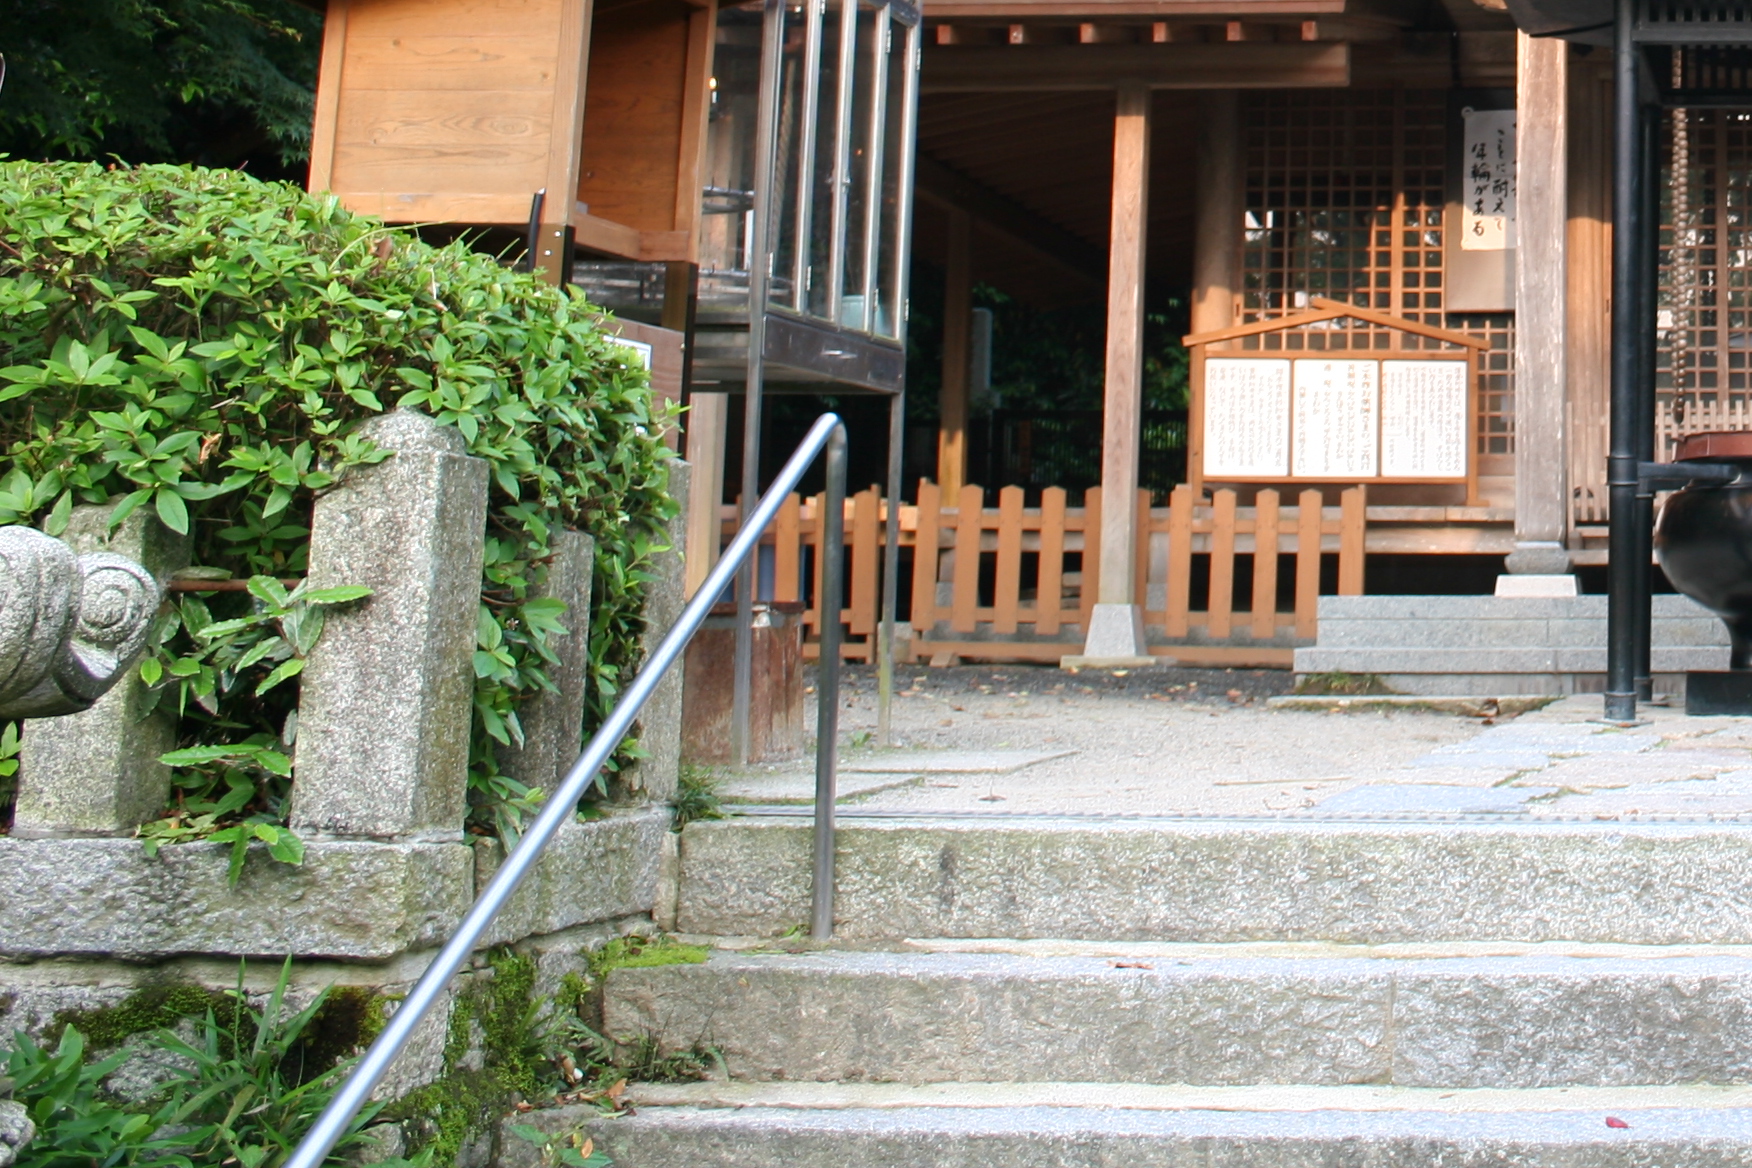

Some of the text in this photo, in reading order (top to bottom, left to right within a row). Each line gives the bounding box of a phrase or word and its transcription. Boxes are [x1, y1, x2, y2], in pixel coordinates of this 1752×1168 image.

[1471, 142, 1490, 236] 年輪がある
